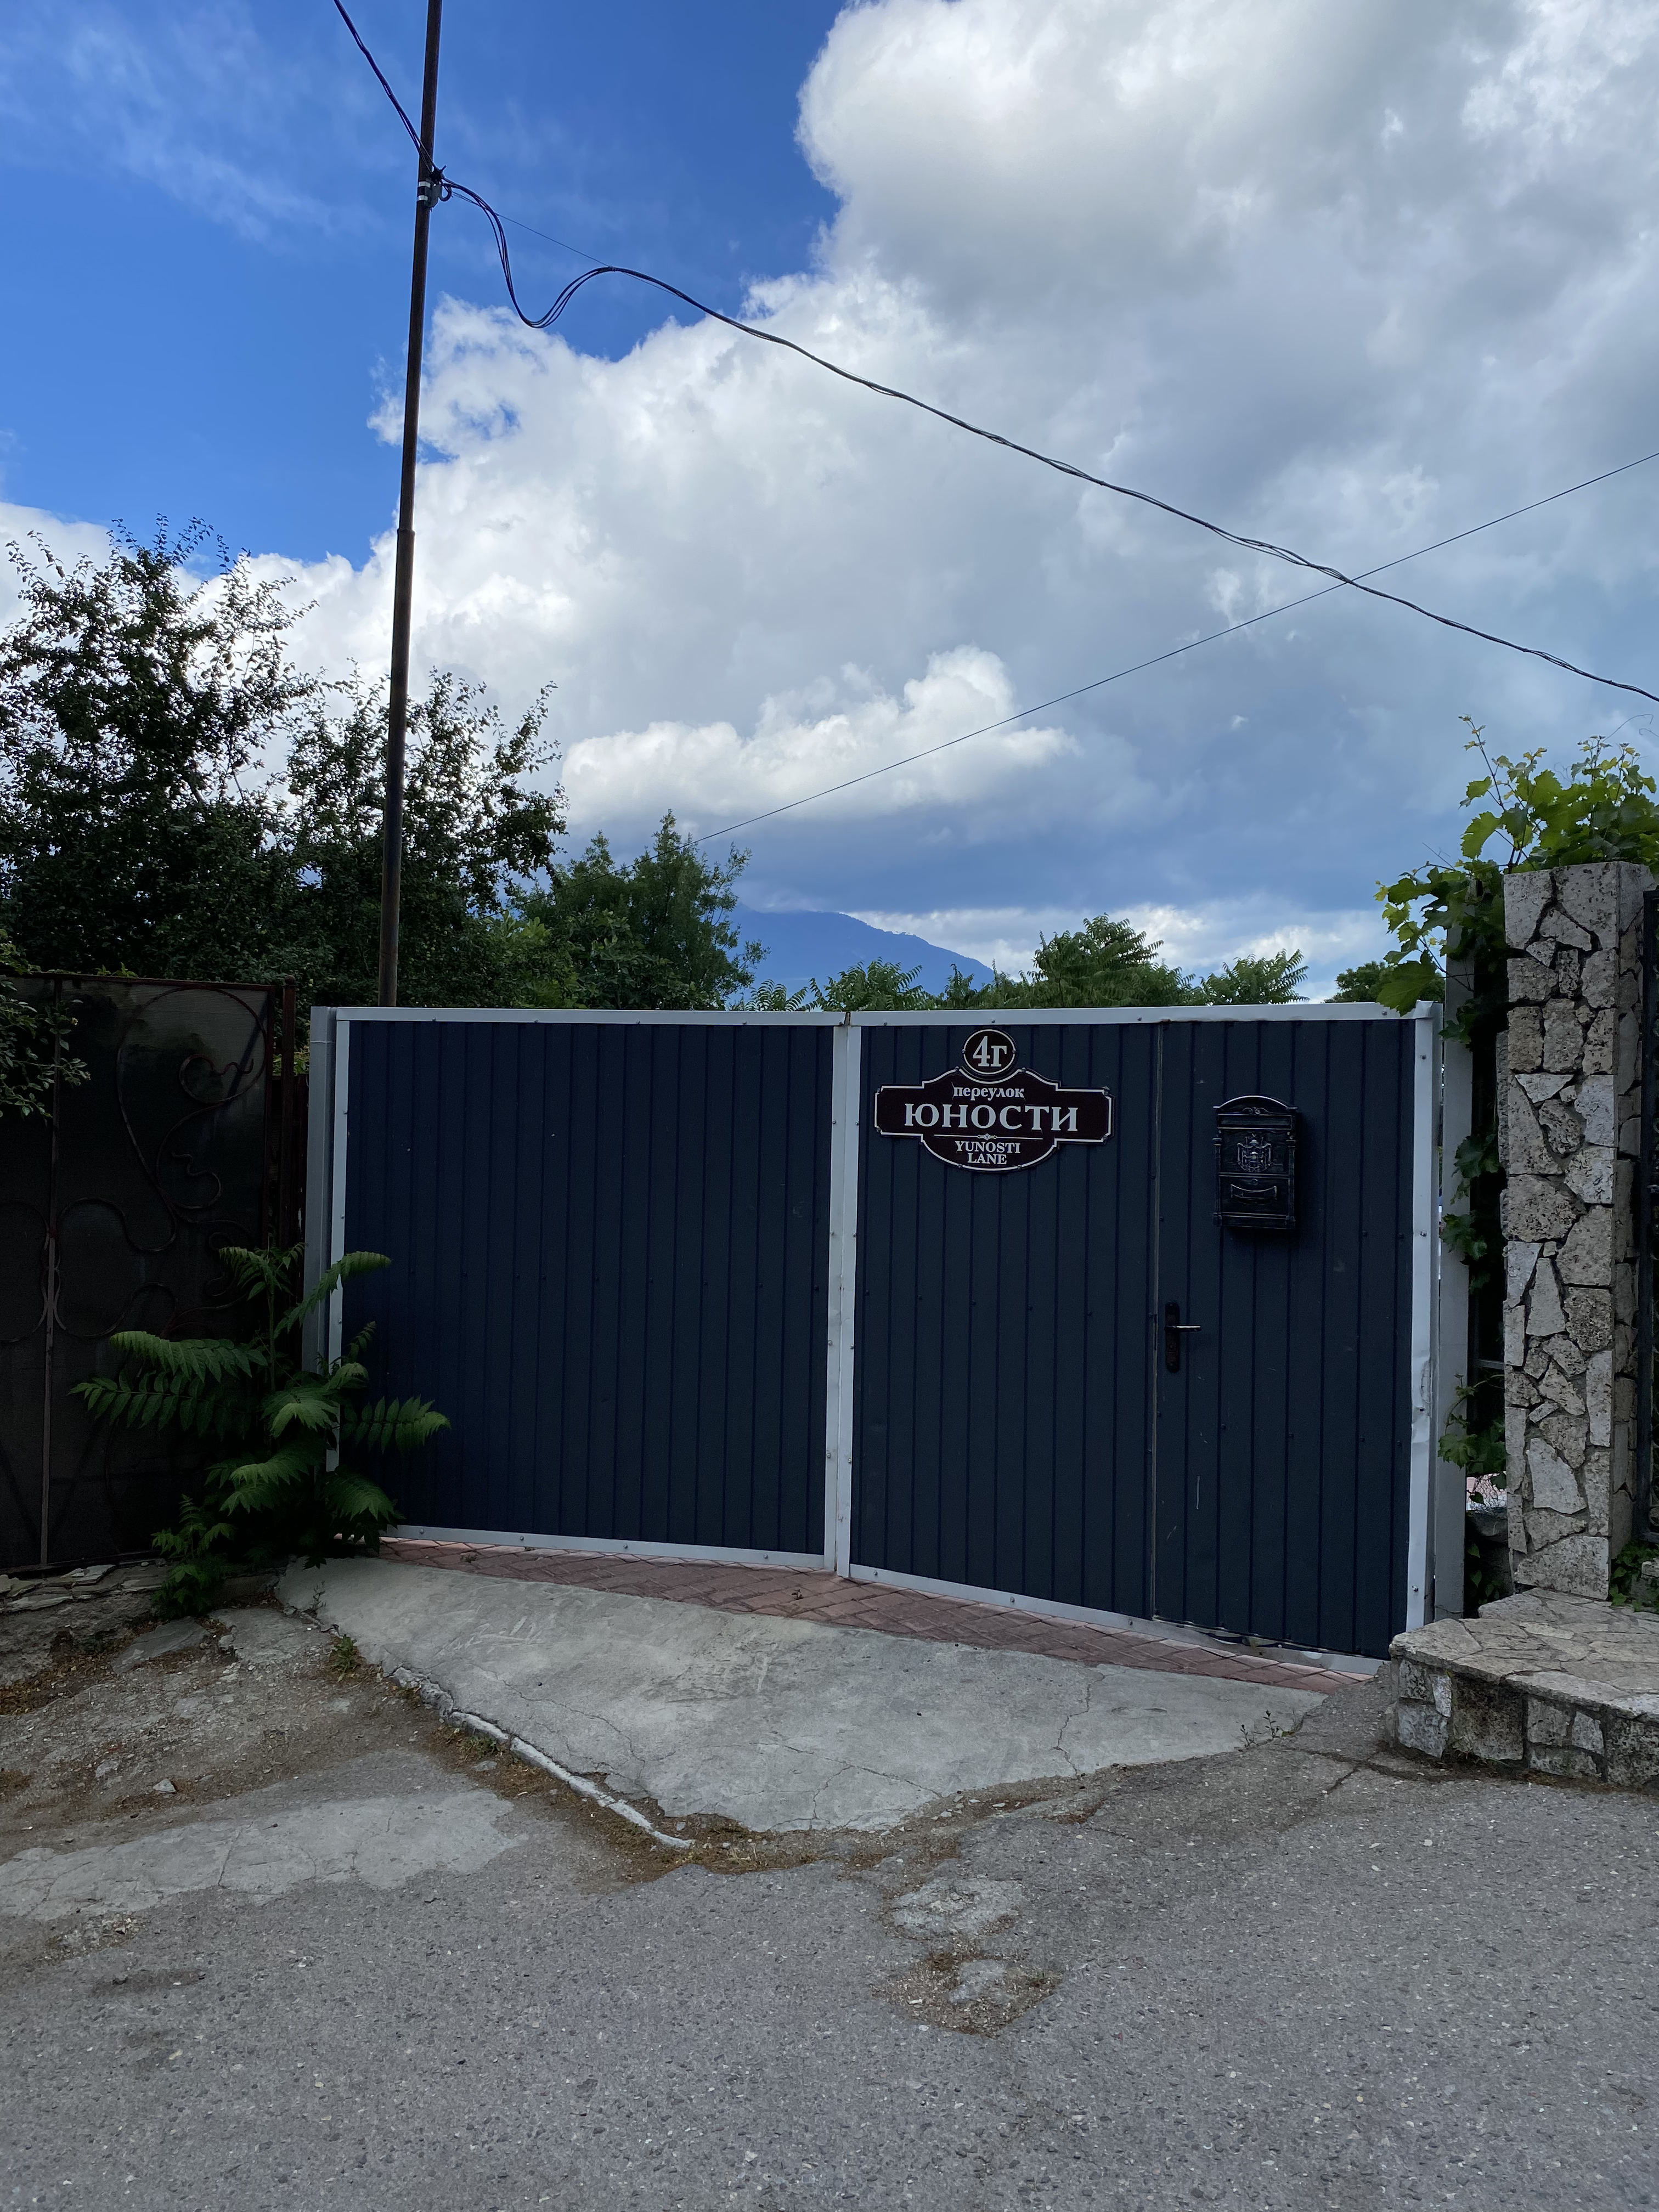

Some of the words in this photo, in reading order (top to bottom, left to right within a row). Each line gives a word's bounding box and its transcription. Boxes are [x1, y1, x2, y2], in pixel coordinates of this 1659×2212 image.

[953, 1086, 1024, 1101] переулок
[904, 1103, 1079, 1132] ЮНОСТИ
[955, 1141, 1021, 1154] YUNOSTI
[967, 1153, 1007, 1165] LANE
